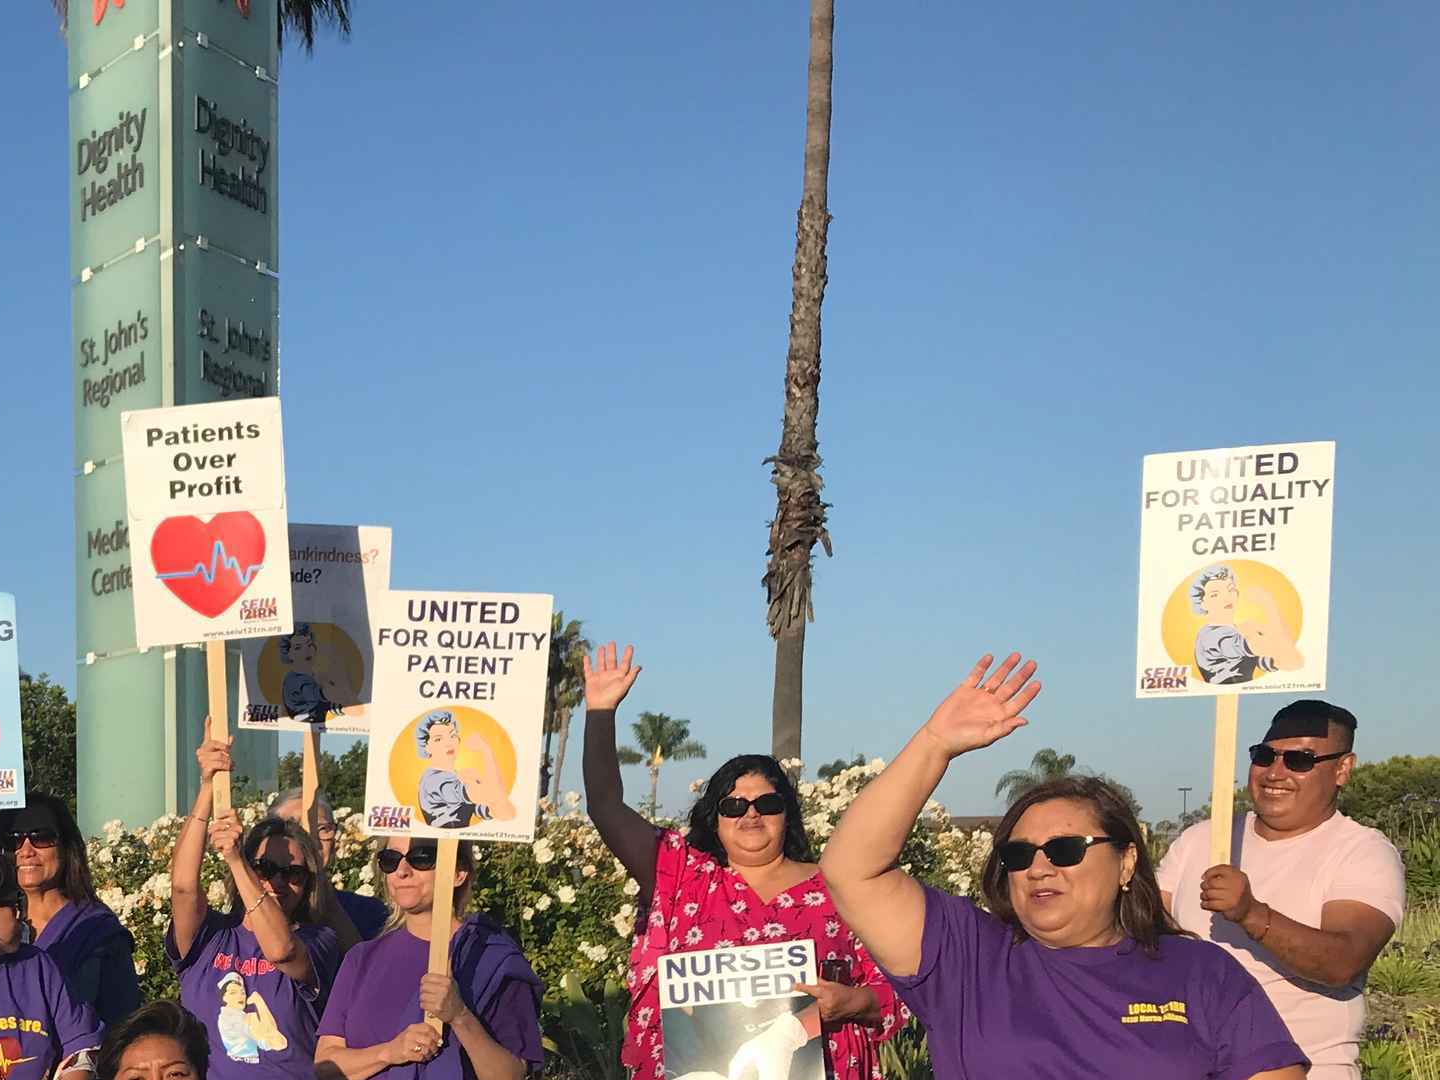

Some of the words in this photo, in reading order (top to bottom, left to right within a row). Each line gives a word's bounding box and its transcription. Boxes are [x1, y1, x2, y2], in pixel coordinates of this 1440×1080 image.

[77, 108, 147, 175] Dignity
[194, 93, 270, 174] Dignity
[80, 154, 145, 222] Health
[80, 337, 100, 368] St.
[101, 310, 149, 366] John's
[83, 351, 146, 408] Regional
[146, 421, 261, 447] Patients
[173, 451, 237, 472] Over
[1176, 452, 1299, 482] UNITED
[169, 476, 243, 500] Profit
[1145, 488, 1200, 509] FOR
[1210, 478, 1330, 504] QUALITY
[1177, 506, 1294, 531] PATIENT
[87, 520, 130, 558] Medic
[1192, 533, 1276, 556] CARE!
[290, 549, 379, 564] ankindness?
[91, 566, 132, 597] Cente
[408, 600, 520, 624] UNITED
[378, 628, 428, 648] FOR
[437, 630, 547, 651] QUALITY
[407, 654, 513, 675] PATIENT
[419, 680, 496, 700] CARE!
[666, 945, 808, 979] NURSES
[668, 971, 807, 1004] UNITED!
[1128, 1003, 1158, 1015] LOCAL
